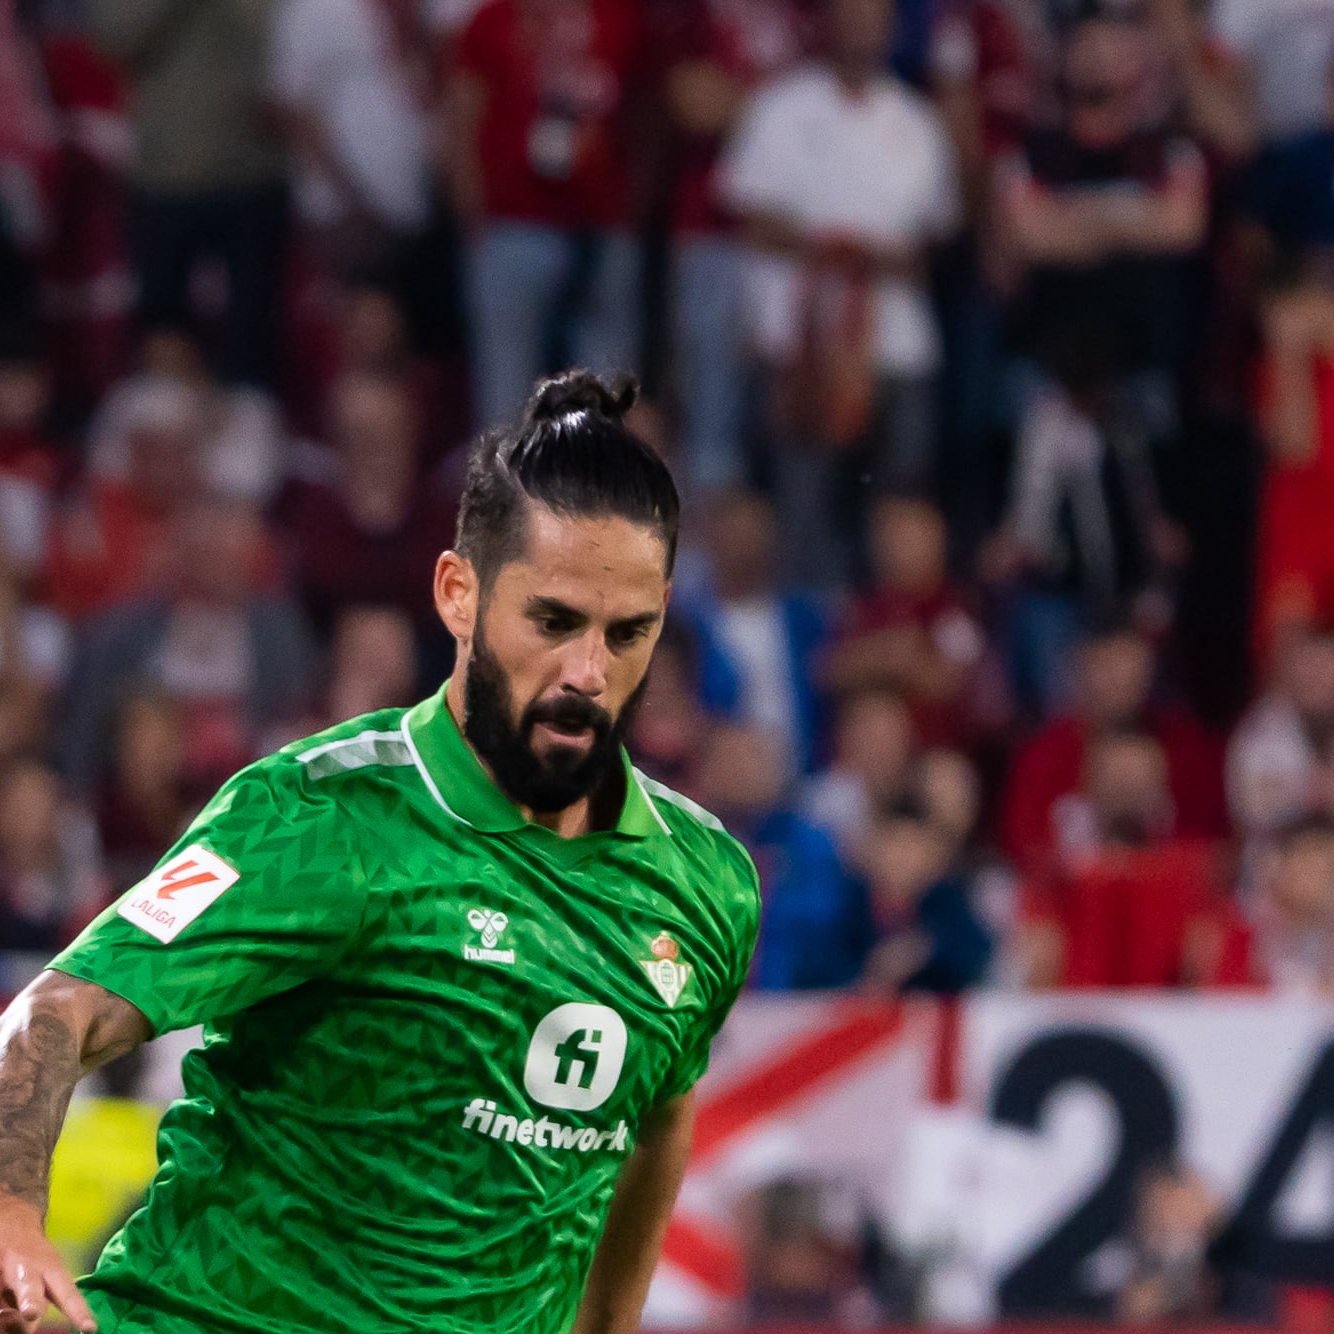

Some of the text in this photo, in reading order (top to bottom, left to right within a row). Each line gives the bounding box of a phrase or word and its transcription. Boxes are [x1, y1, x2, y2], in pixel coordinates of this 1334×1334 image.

[130, 899, 176, 929] LALIGA
[463, 944, 516, 965] hummel
[461, 1097, 629, 1153] finetwork
